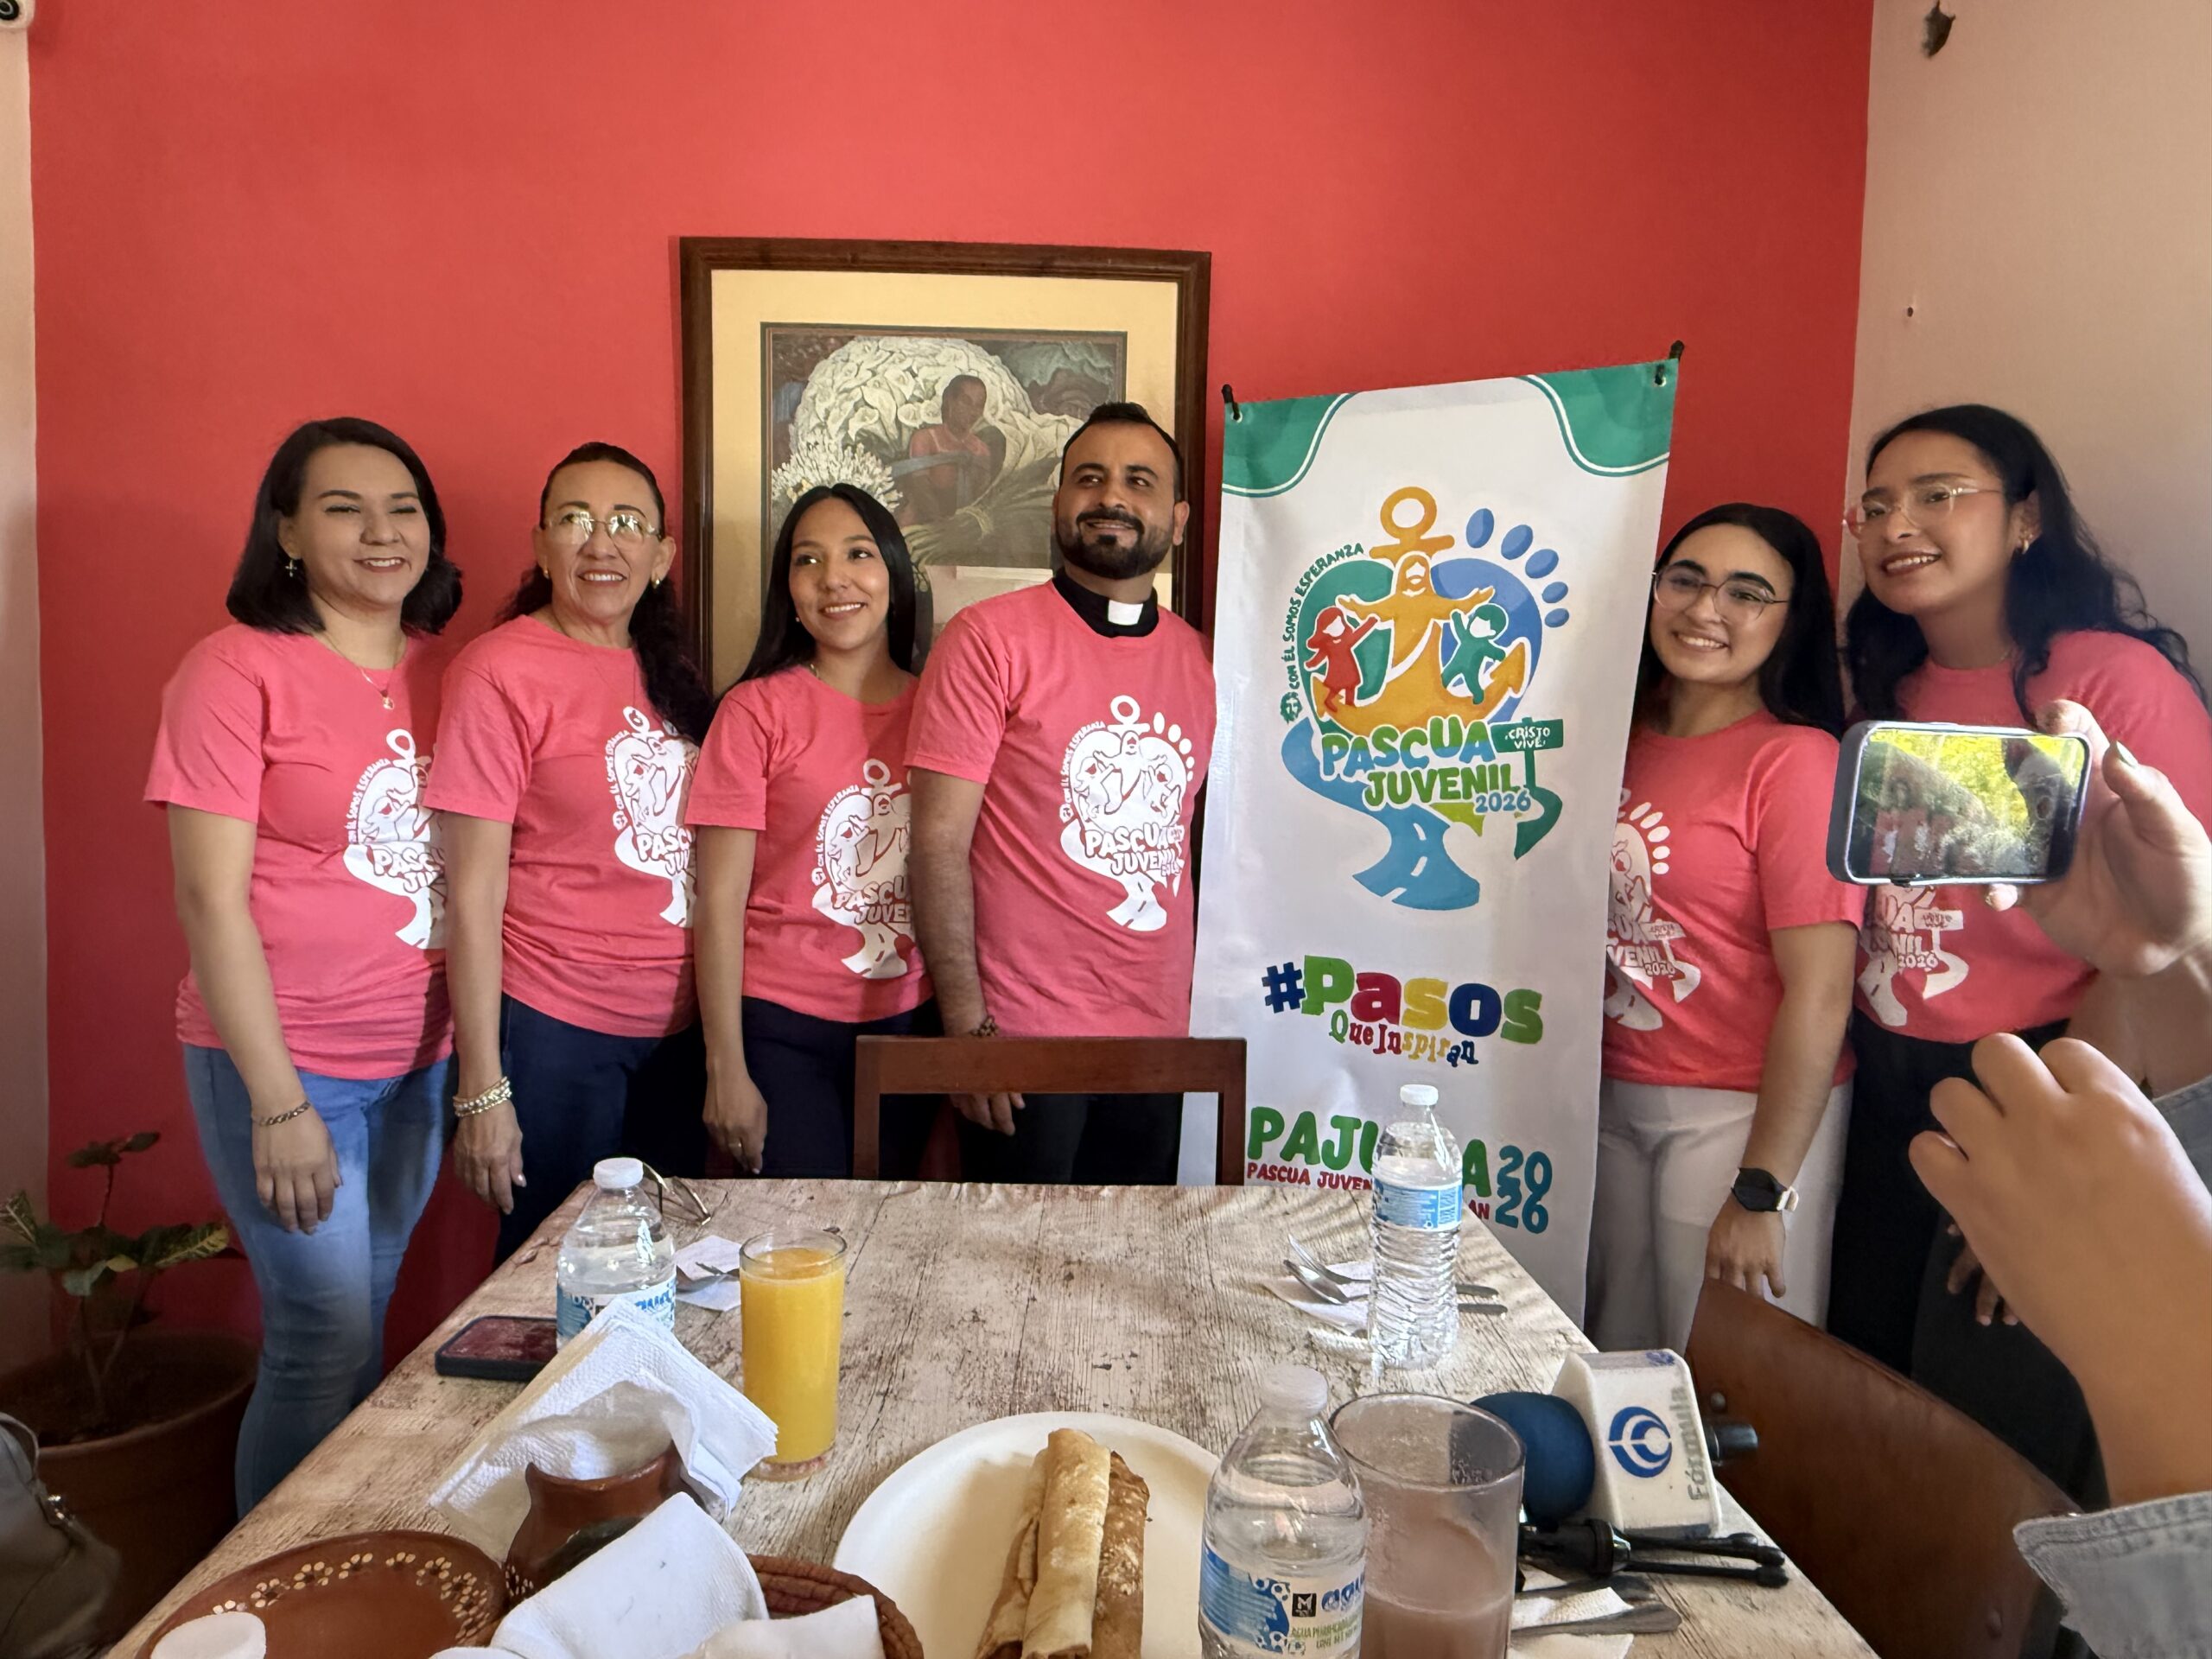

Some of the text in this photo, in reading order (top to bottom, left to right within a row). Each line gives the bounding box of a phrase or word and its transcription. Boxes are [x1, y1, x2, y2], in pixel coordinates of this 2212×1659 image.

[1294, 543, 1364, 597] ESPERANZA
[1321, 715, 1496, 777] PASCUA
[1364, 763, 1521, 807] JUVENIL
[1475, 791, 1531, 813] 2026
[1084, 822, 1170, 860] PASCUA
[1262, 955, 1543, 1045] #Pasos
[1247, 1162, 1312, 1185] PASCUA
